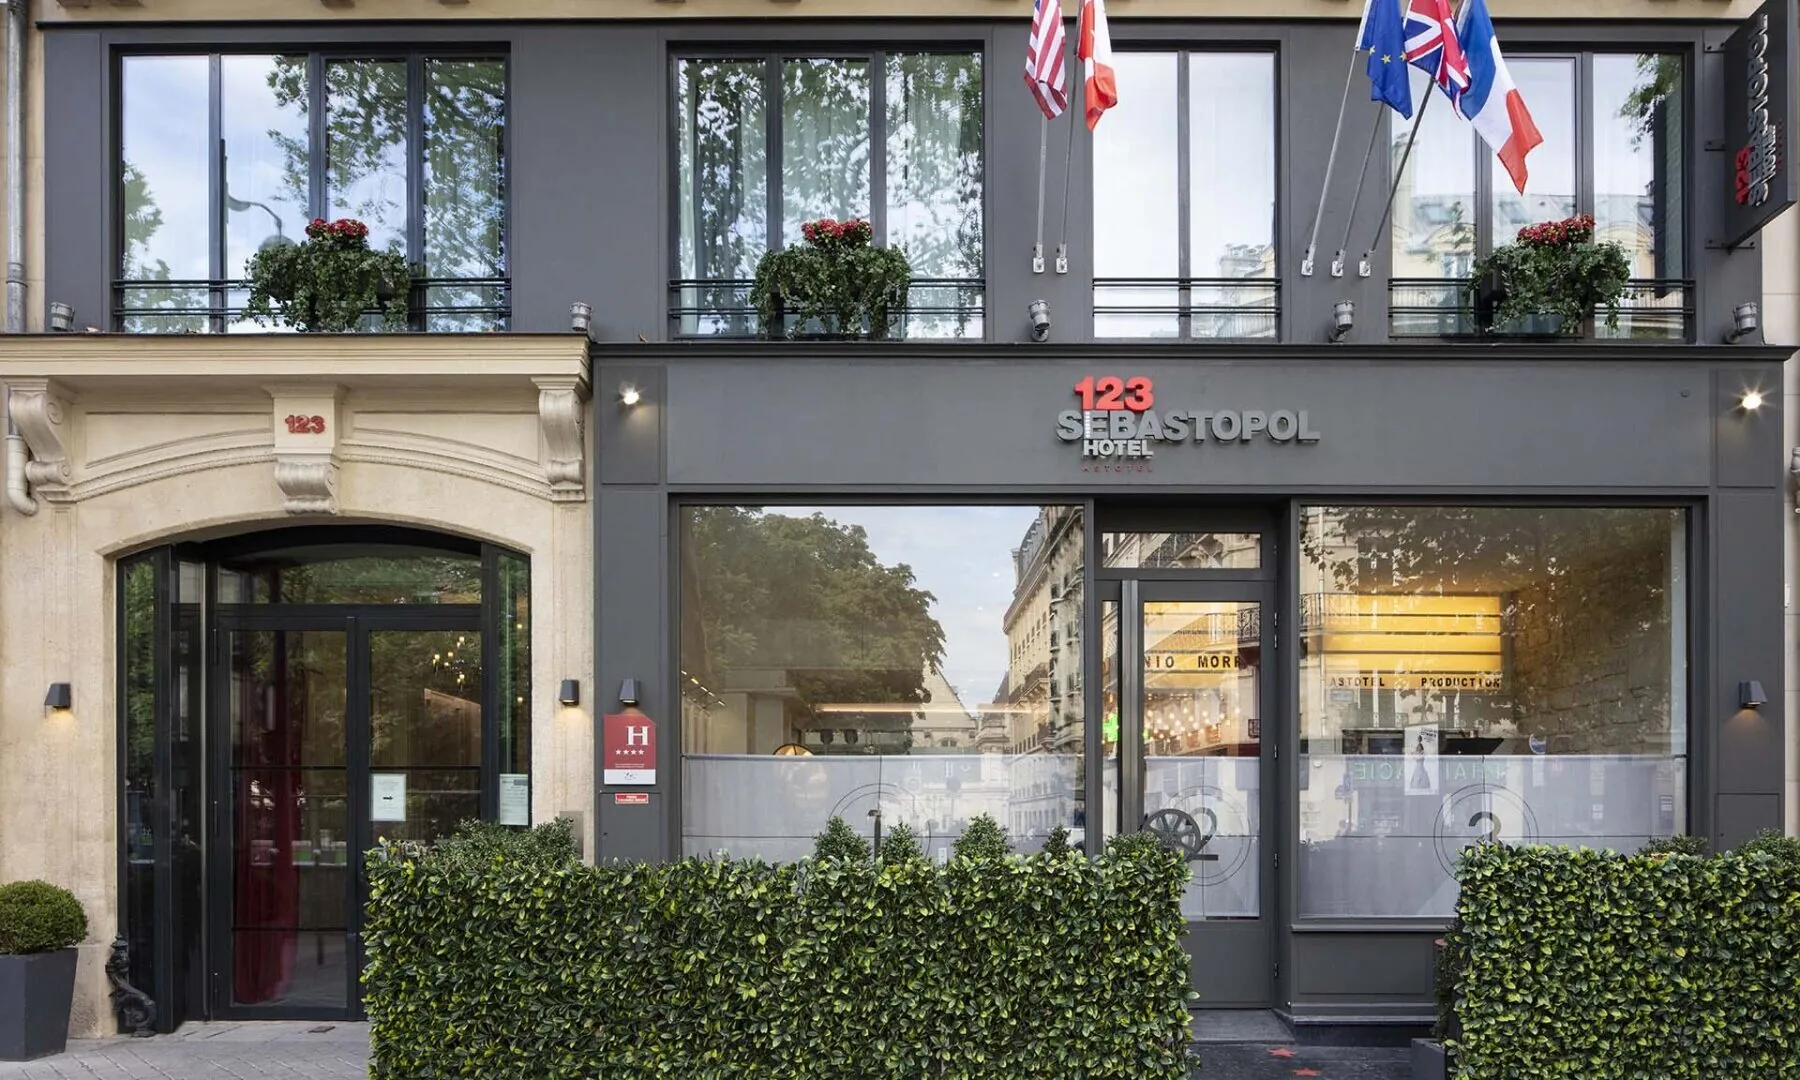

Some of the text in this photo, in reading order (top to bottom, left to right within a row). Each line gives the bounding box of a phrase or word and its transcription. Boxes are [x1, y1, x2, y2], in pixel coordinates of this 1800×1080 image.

[1735, 144, 1755, 205] 123
[1074, 376, 1154, 411] 123
[285, 414, 326, 434] 123
[1056, 409, 1320, 443] SEBASTOPOL
[1083, 439, 1154, 457] HOTEL
[626, 726, 649, 746] H
